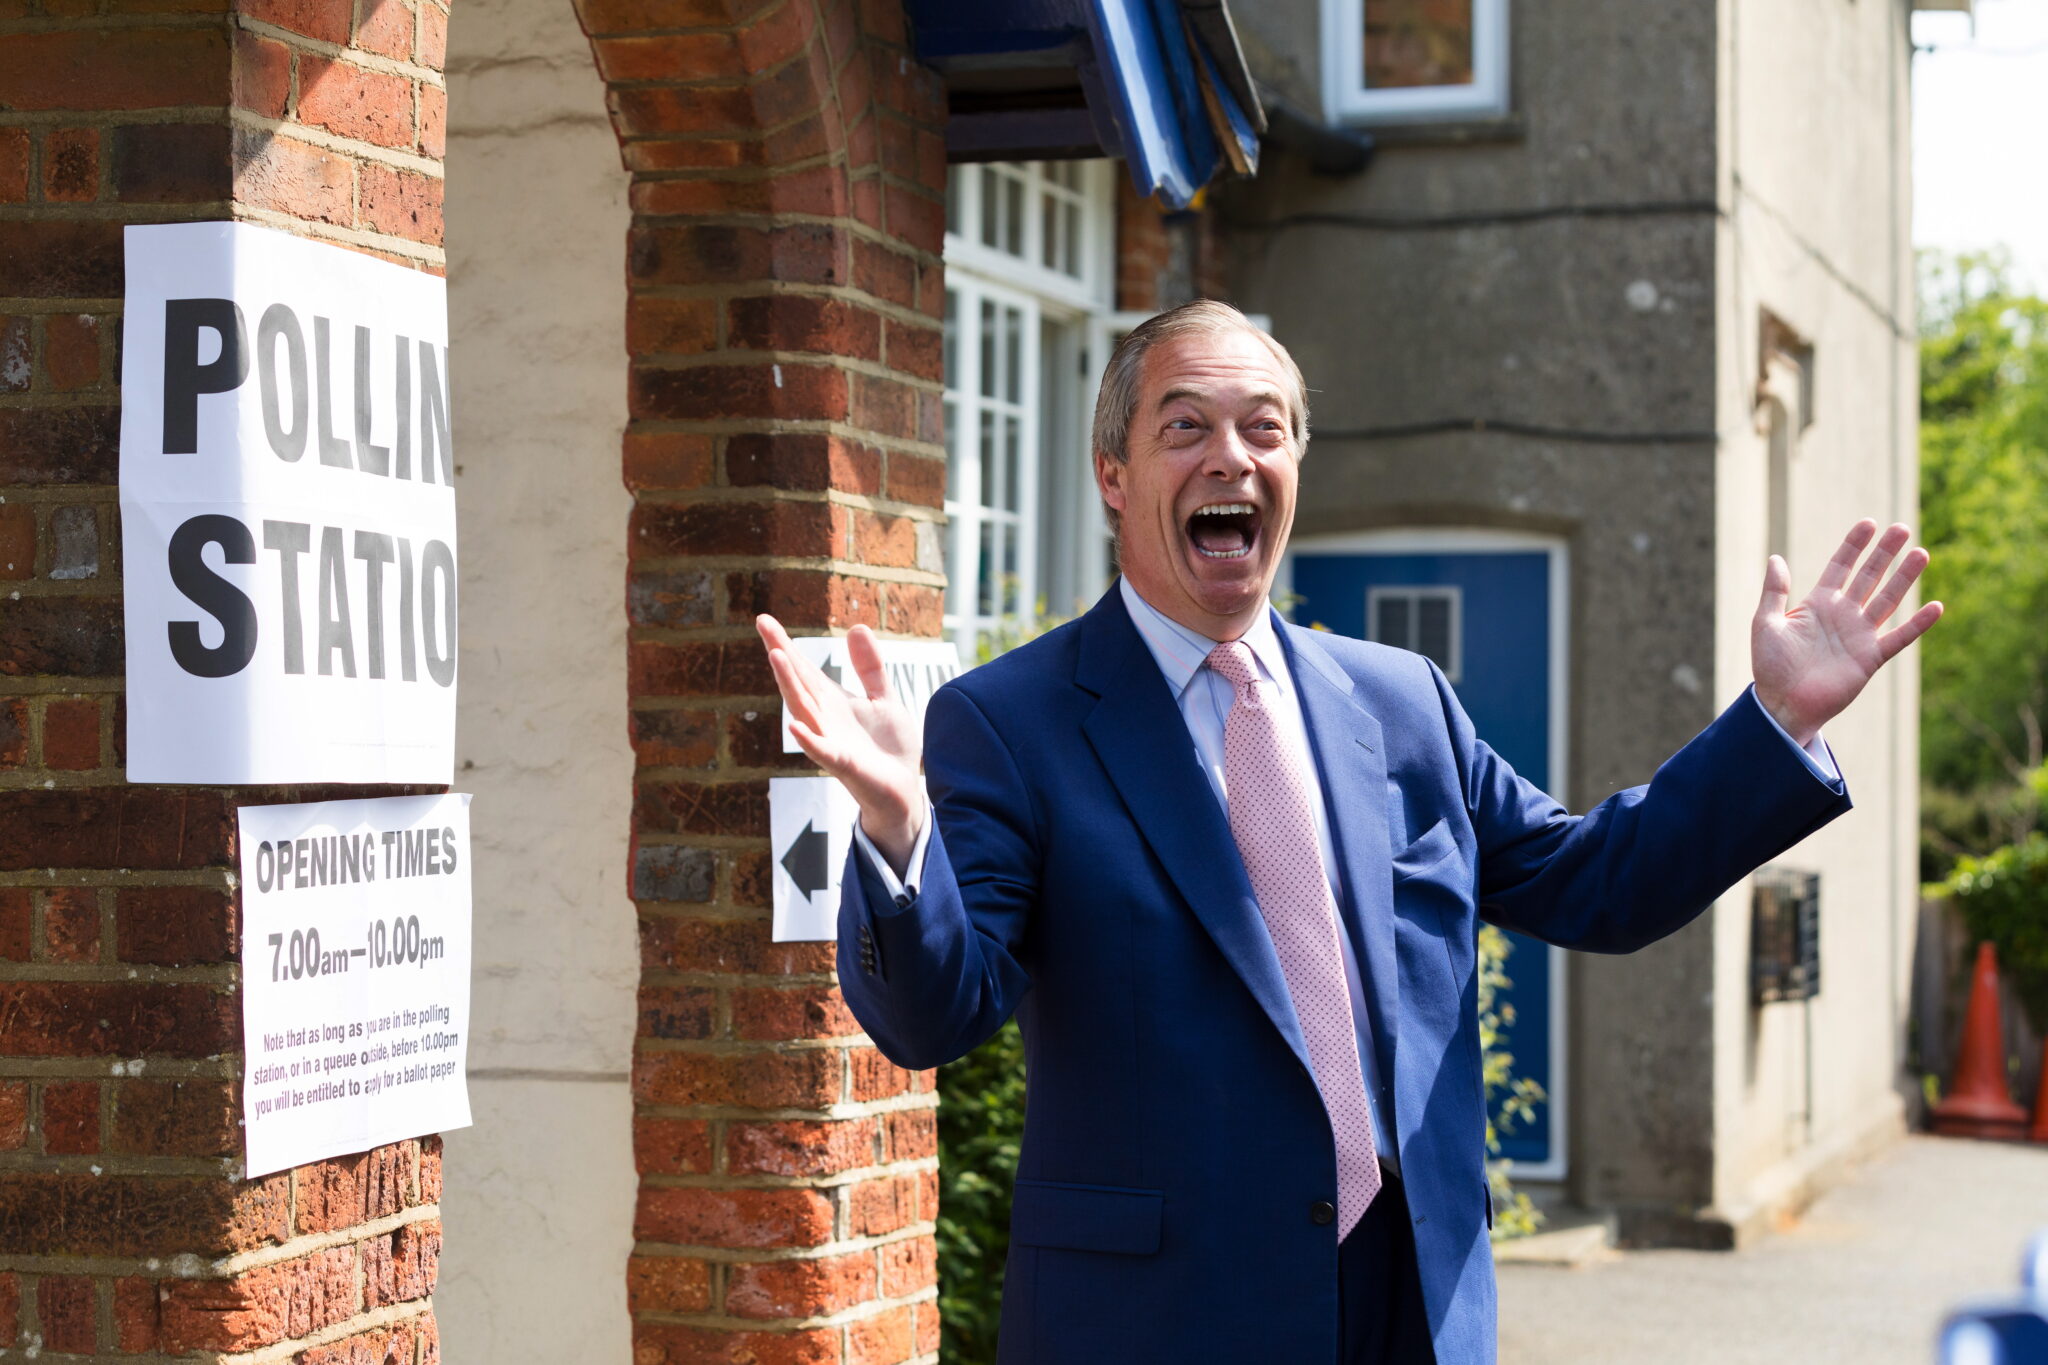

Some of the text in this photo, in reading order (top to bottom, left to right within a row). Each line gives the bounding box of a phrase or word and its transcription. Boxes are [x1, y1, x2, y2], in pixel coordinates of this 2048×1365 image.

[167, 513, 457, 688] STATIO
[885, 662, 918, 718] AY
[256, 826, 457, 894] OPENING TIMES
[264, 1032, 284, 1052] Note
[287, 1027, 306, 1048] that
[308, 1028, 320, 1044] as
[322, 1023, 345, 1044] long
[349, 1022, 363, 1037] as
[379, 1016, 391, 1032] are
[393, 1010, 401, 1028] in
[403, 1009, 417, 1027] the
[419, 1004, 450, 1029] polling
[254, 1031, 458, 1085] station, or in a queue otside, before 10.00pm
[255, 1098, 272, 1121] you
[274, 1090, 290, 1111] will
[292, 1089, 304, 1107] be
[306, 1079, 345, 1104] entitled
[348, 1078, 360, 1096] to
[384, 1069, 394, 1088] for
[396, 1070, 402, 1085] a
[404, 1062, 428, 1084] ballot
[430, 1061, 456, 1083] paper
